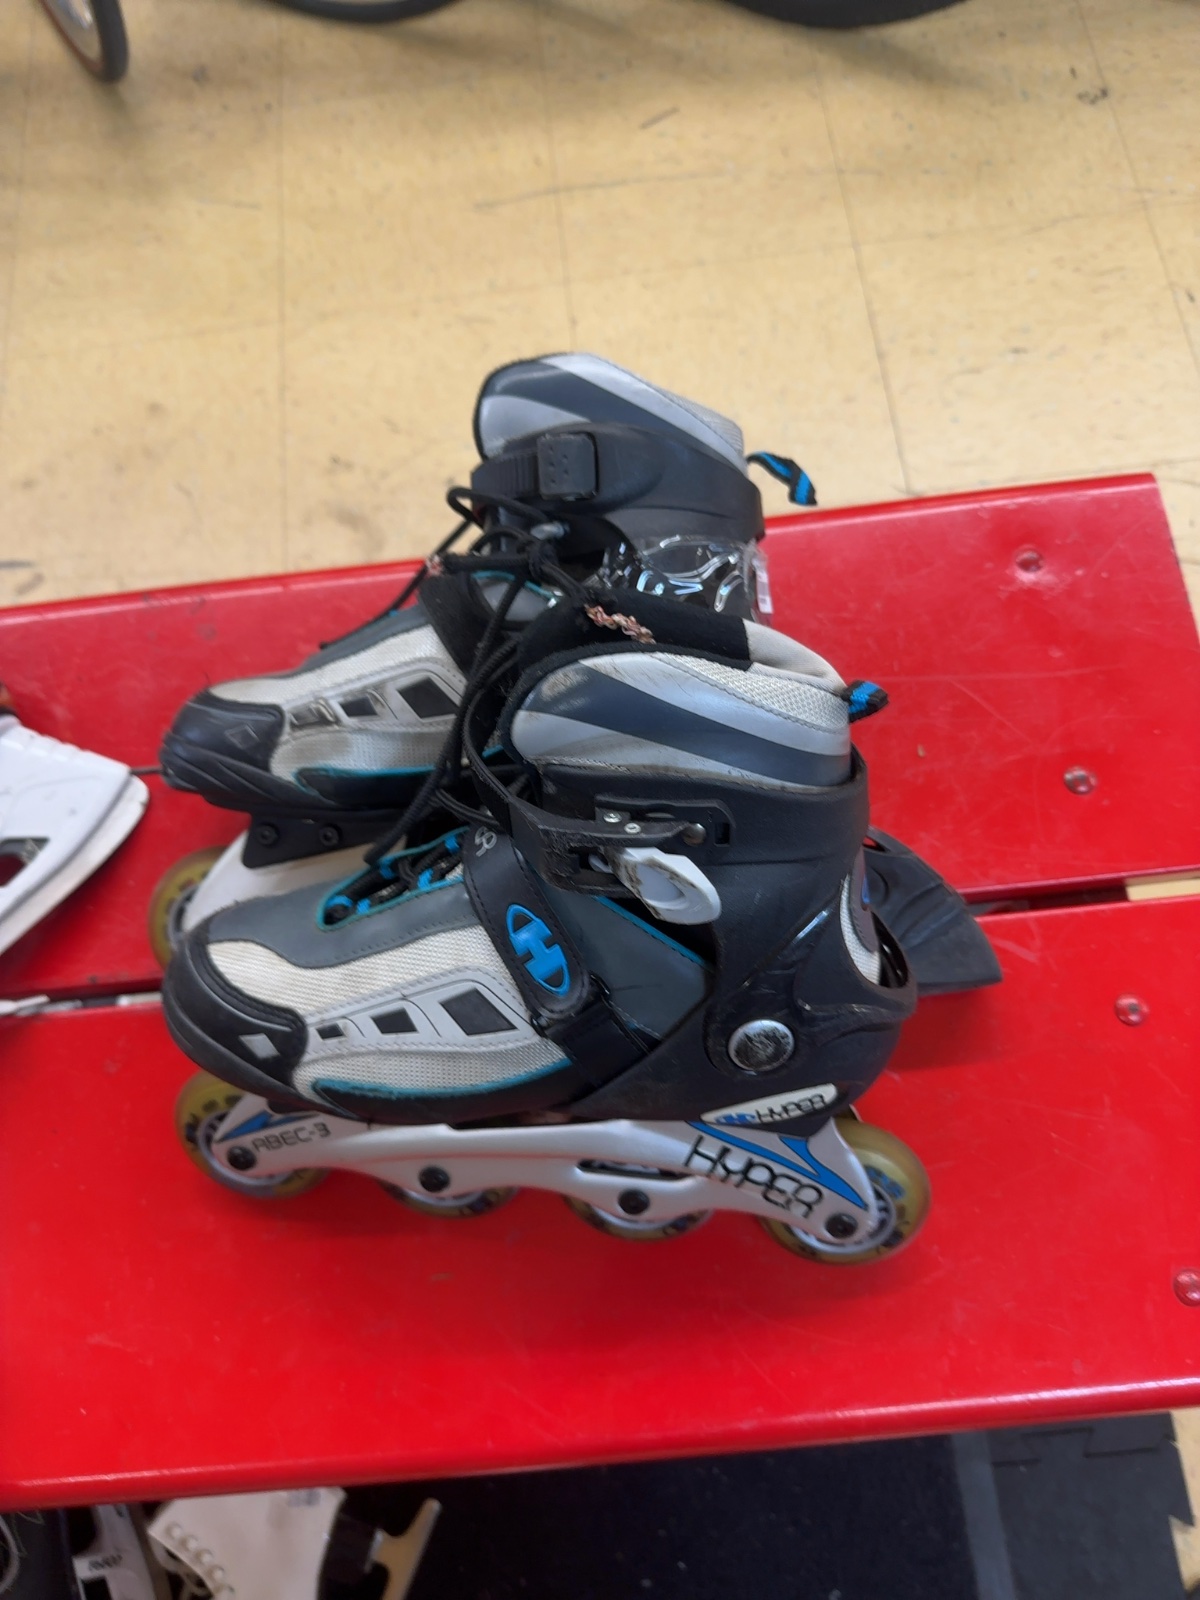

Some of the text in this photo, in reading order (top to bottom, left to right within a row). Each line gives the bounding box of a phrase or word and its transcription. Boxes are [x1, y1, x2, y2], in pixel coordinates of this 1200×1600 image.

[755, 1093, 827, 1123] HYPER
[252, 1122, 331, 1152] ABEC-3
[683, 1134, 823, 1219] HYPER
